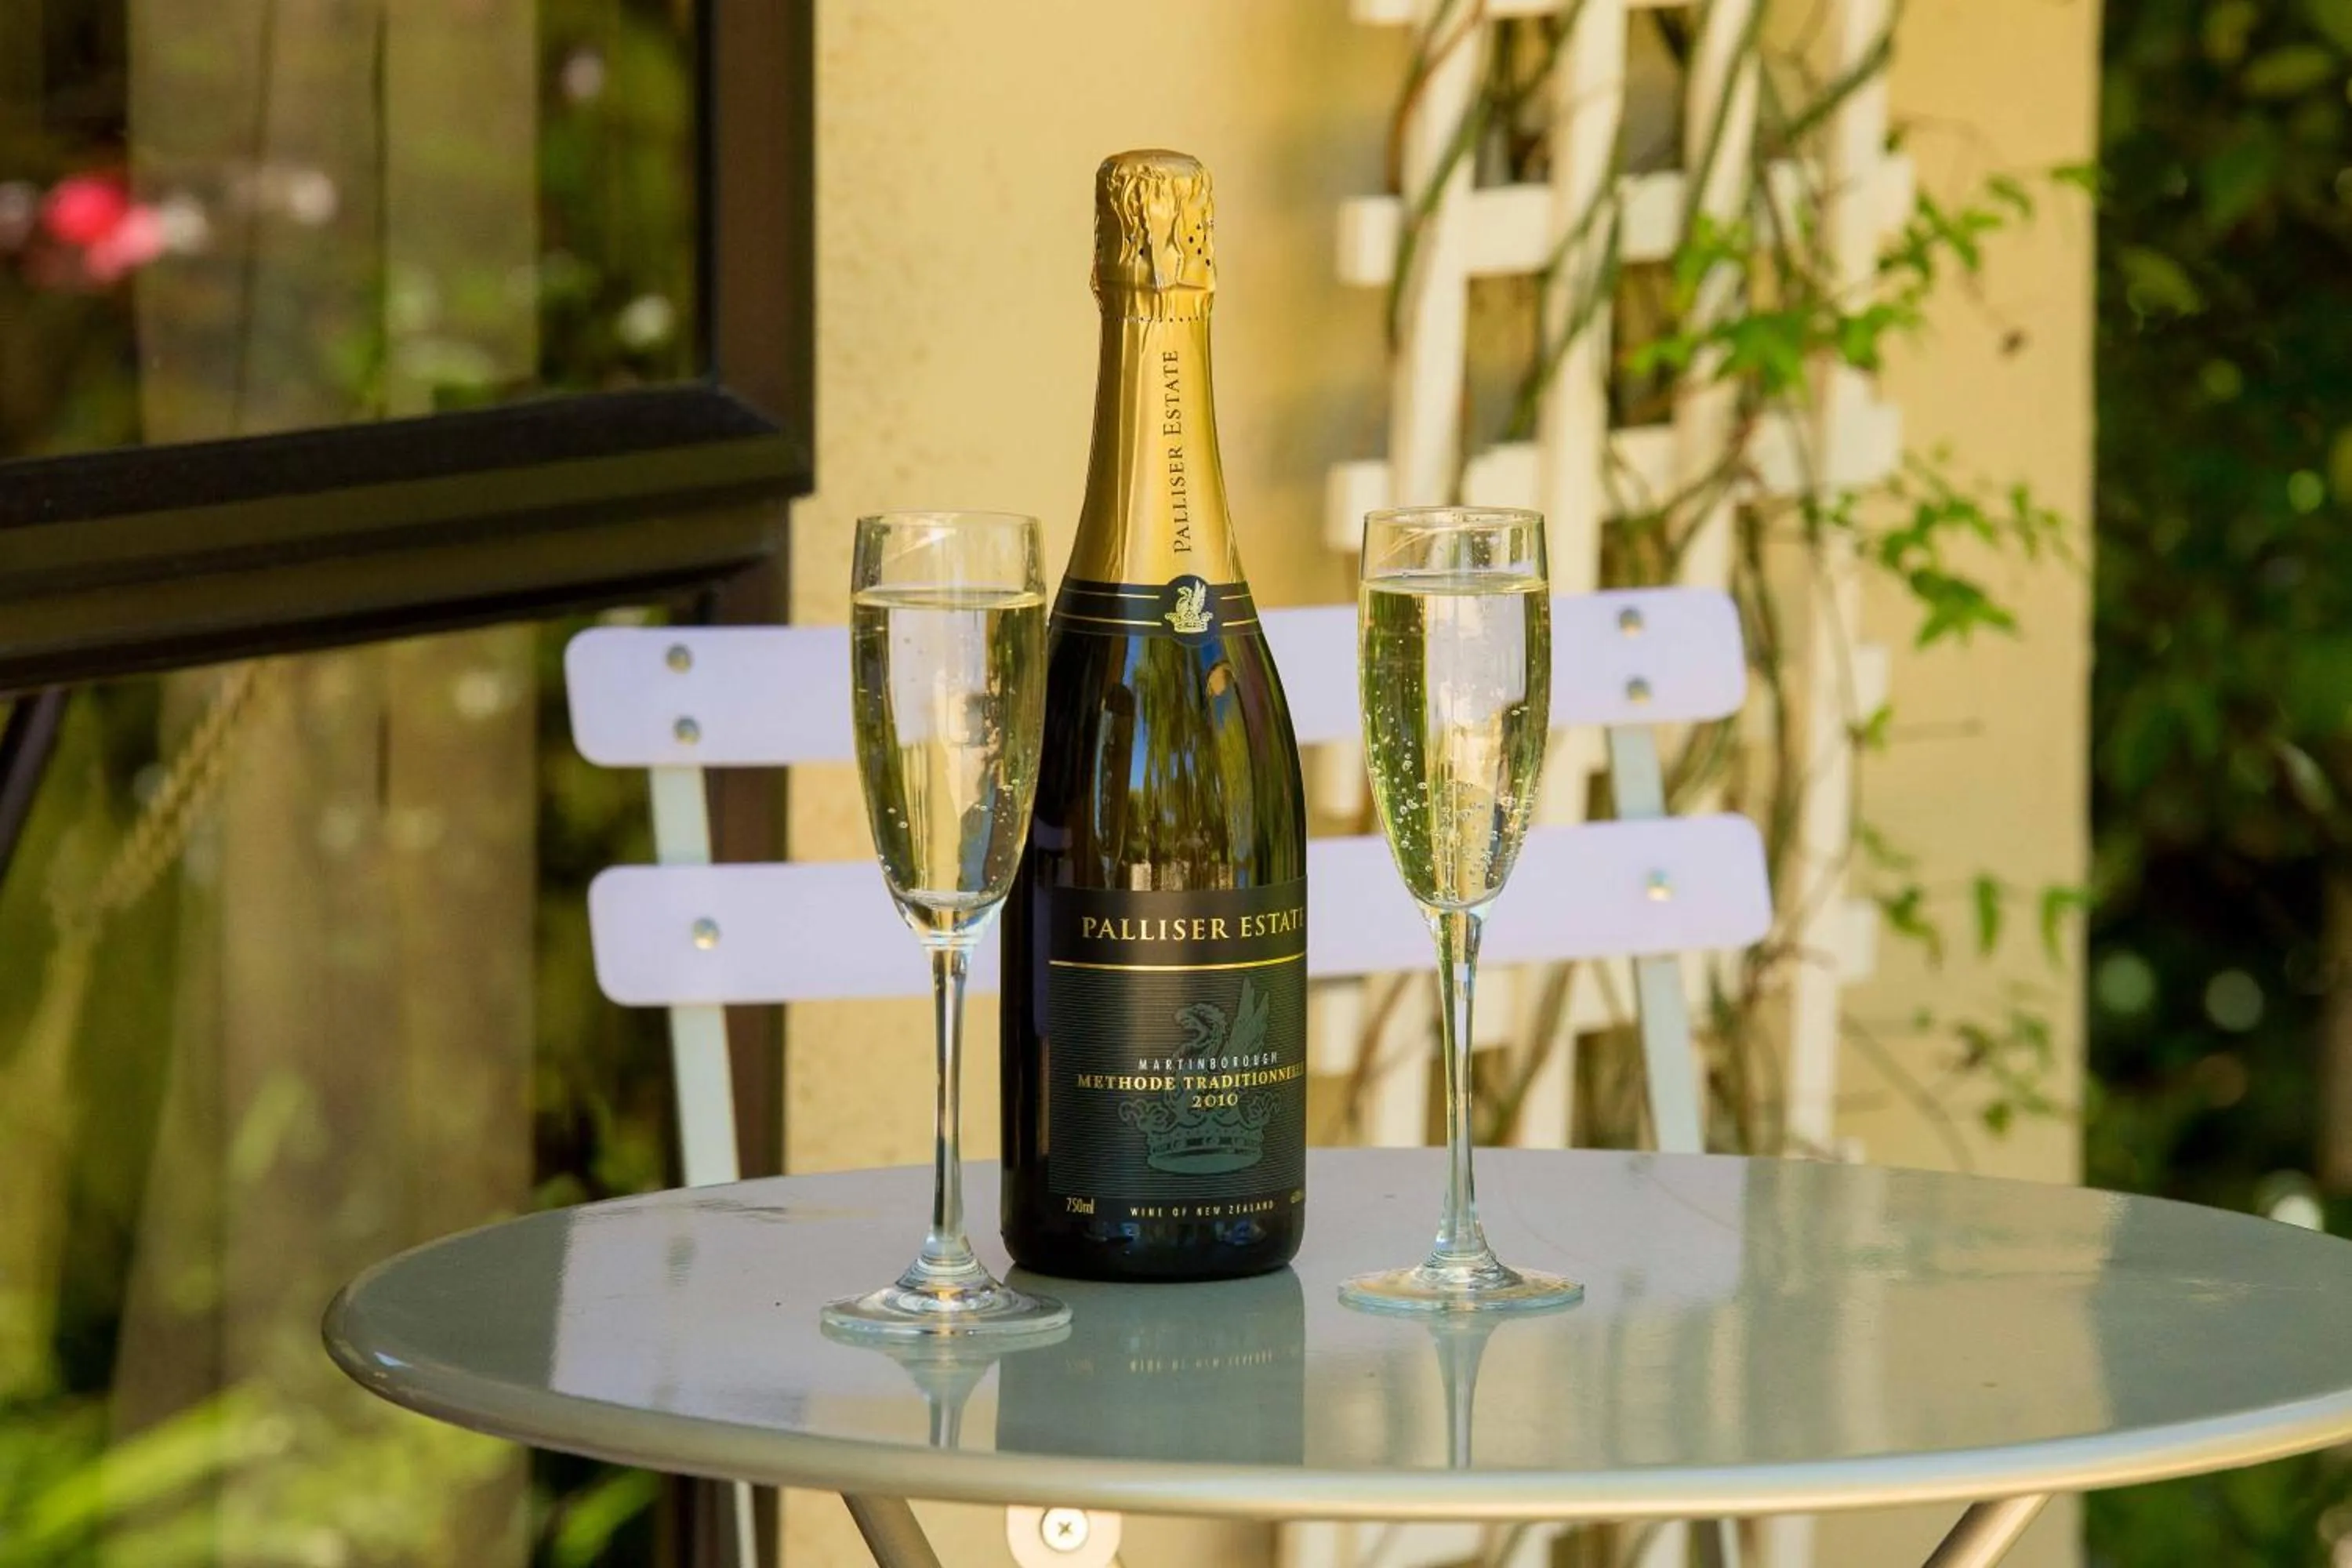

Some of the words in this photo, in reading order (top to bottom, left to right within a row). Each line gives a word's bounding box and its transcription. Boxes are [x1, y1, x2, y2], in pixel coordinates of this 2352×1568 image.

[1163, 350, 1182, 436] ESTATE
[1168, 445, 1192, 553] PALLISER
[1082, 916, 1230, 941] PALLISER
[1138, 1051, 1277, 1071] MARTINBOROUGH
[1077, 1074, 1176, 1091] METHODE
[1192, 1093, 1239, 1109] 2010
[1066, 1197, 1094, 1214] 750ml
[1196, 1206, 1221, 1216] NEW
